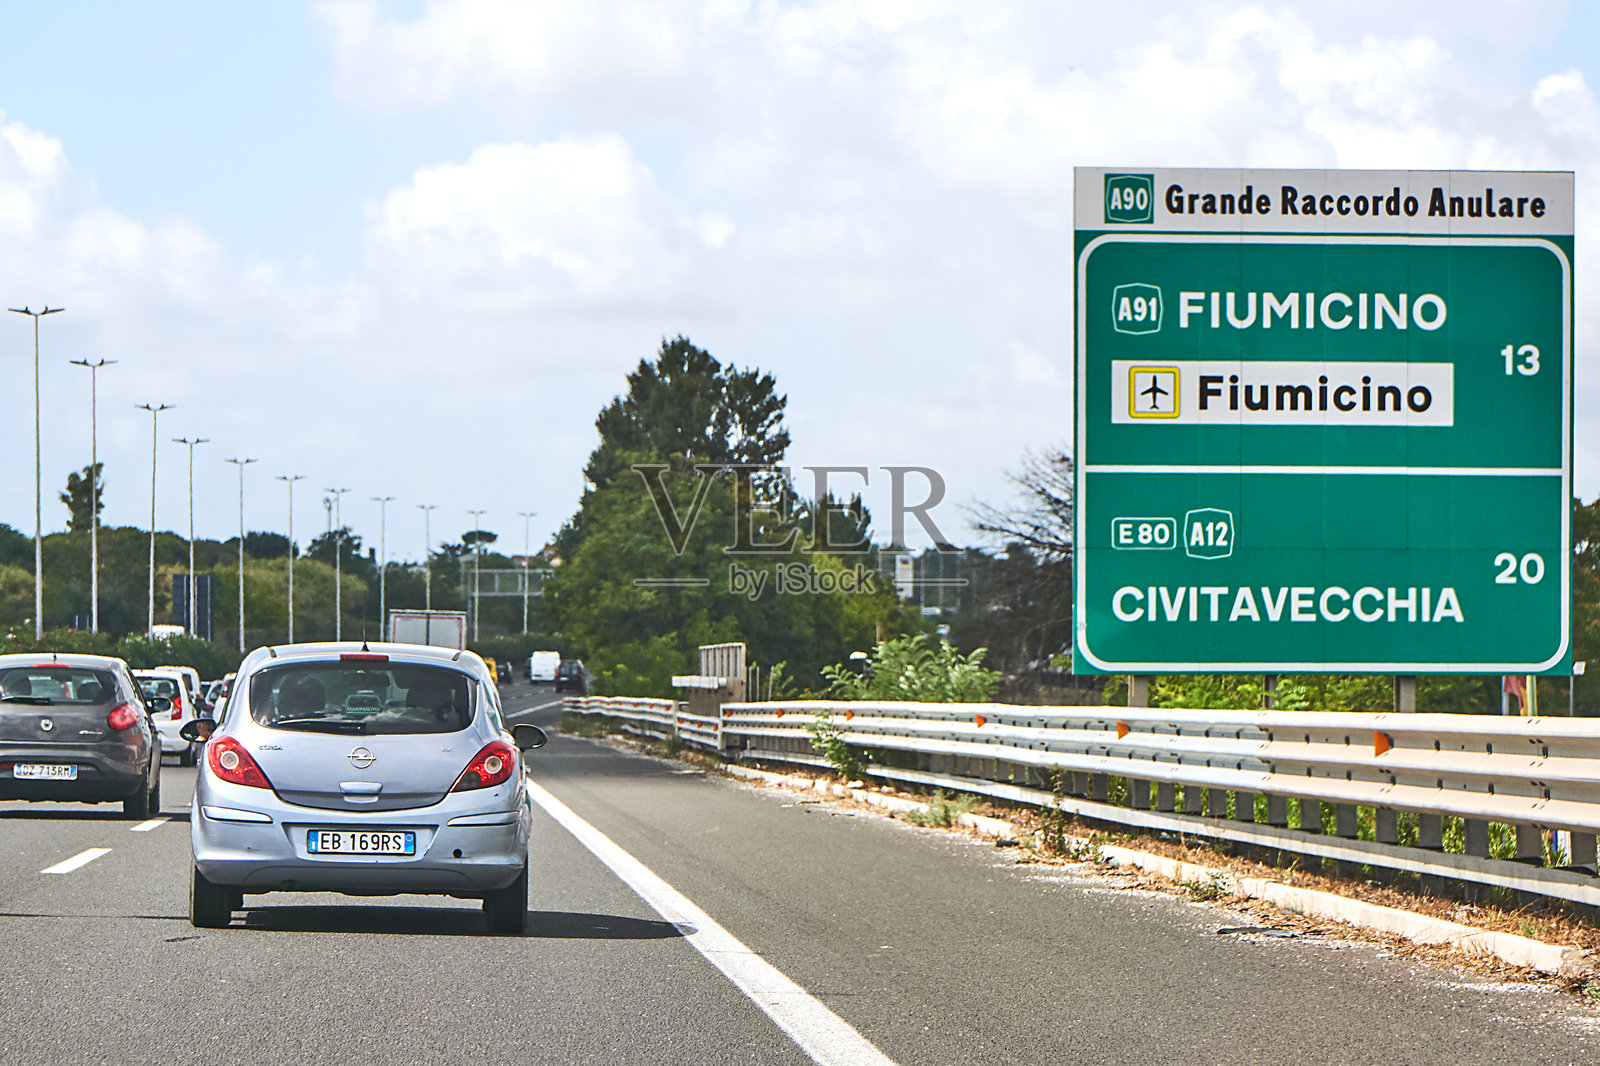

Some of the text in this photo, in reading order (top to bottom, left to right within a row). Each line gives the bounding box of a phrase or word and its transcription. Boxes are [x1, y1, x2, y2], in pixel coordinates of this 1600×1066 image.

[1110, 184, 1546, 218] A90 Grande Raccordo Anulare
[1118, 291, 1447, 331] A91 FIUMICINO
[1500, 344, 1540, 376] 13
[1199, 374, 1432, 413] Fiumicino
[1119, 523, 1170, 544] E 80
[1190, 521, 1228, 546] A12
[1494, 552, 1545, 584] 20
[1111, 586, 1465, 623] CIVITAVECCHIA
[320, 833, 341, 850] EB
[350, 833, 402, 851] 169RS
